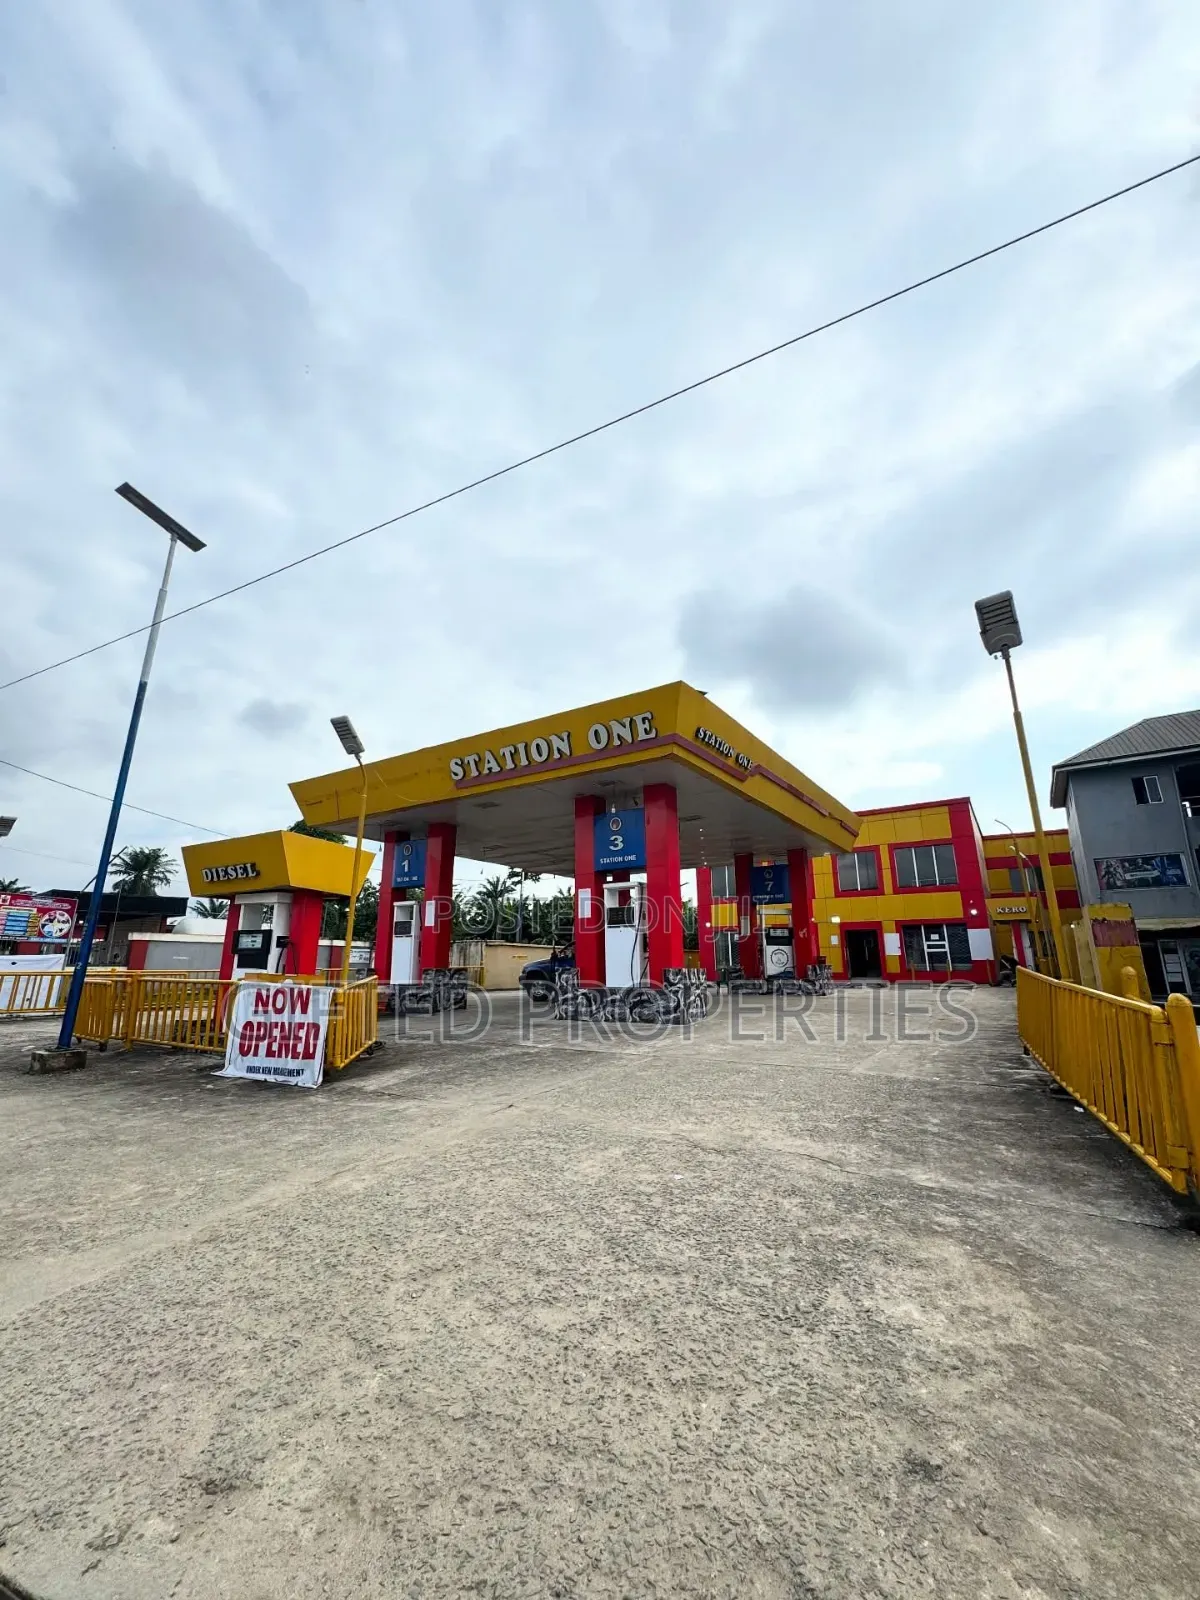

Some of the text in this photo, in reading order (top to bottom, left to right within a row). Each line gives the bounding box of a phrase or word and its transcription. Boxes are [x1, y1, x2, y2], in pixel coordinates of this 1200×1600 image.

[450, 711, 658, 782] STATION ONE
[697, 727, 753, 770] STATION ONE
[608, 835, 625, 851] 3
[401, 859, 410, 873] 1
[599, 854, 637, 864] STATION ONE
[201, 863, 257, 882] DIESEL
[764, 881, 774, 892] 7
[996, 906, 1027, 914] KERO
[254, 987, 312, 1015] NOW
[238, 1020, 321, 1060] OPENED
